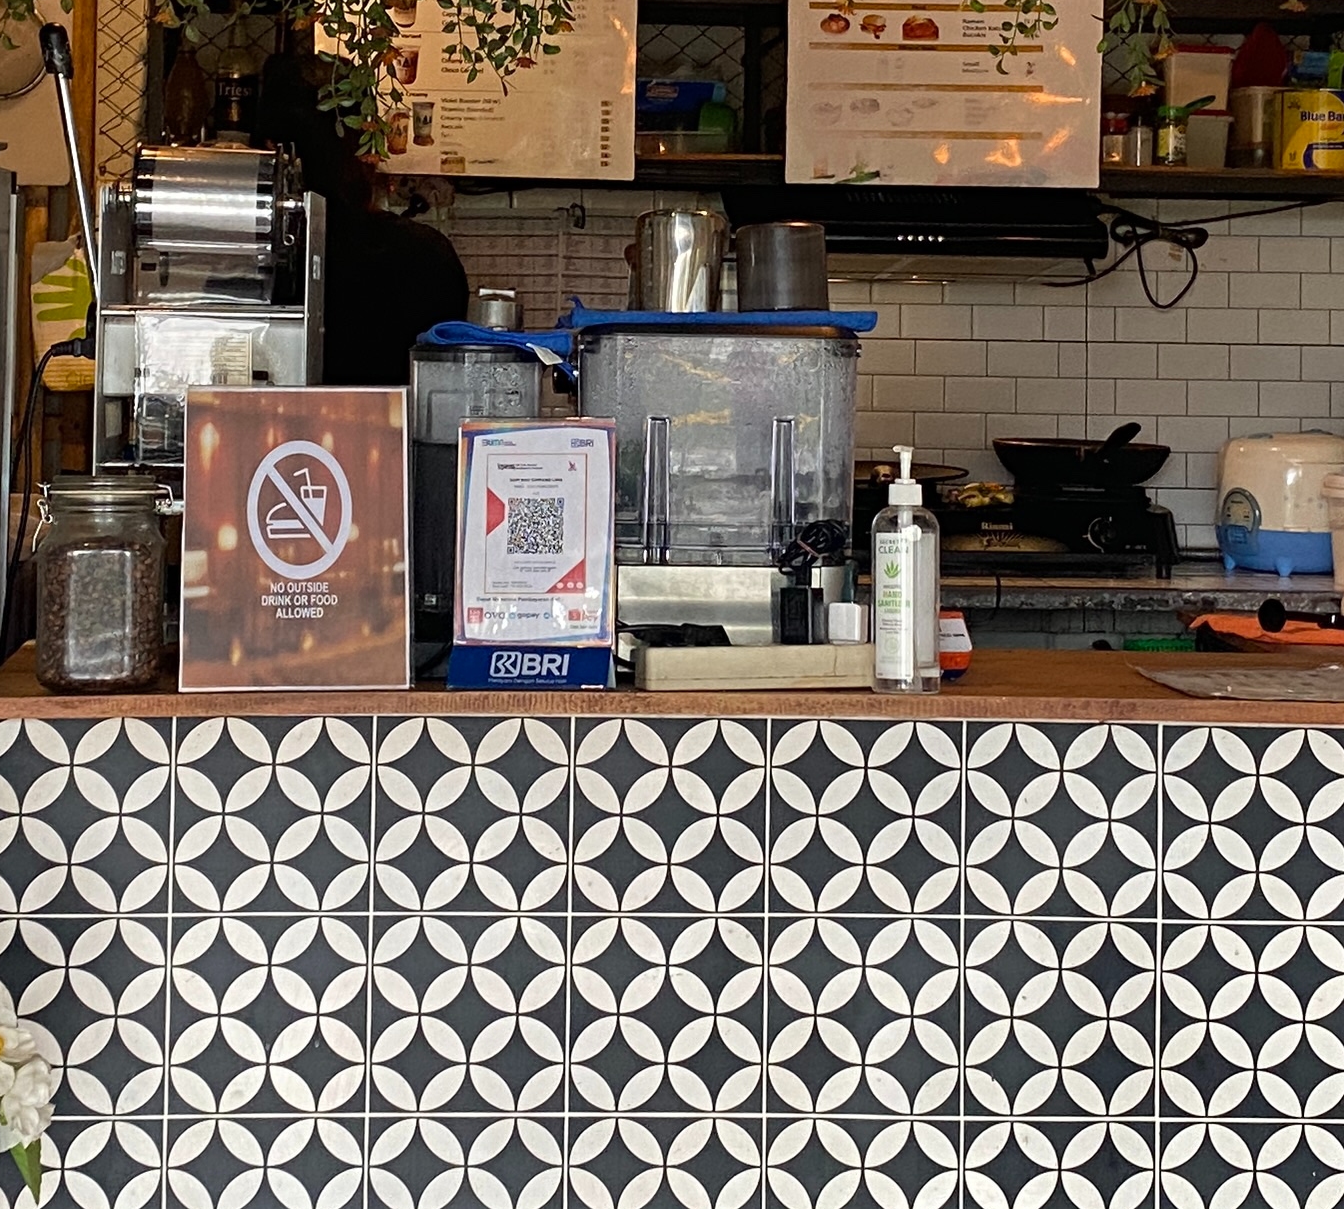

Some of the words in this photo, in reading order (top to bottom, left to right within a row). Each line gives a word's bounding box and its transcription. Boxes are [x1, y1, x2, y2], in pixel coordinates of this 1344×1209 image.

[1300, 110, 1326, 122] Blue
[270, 582, 284, 594] NO
[286, 582, 329, 594] OUTSIDE
[261, 594, 293, 606] DRINK
[294, 594, 308, 606] OR
[310, 594, 338, 606] FOOD
[275, 606, 324, 619] ALLOWED
[521, 653, 570, 676] BRI
